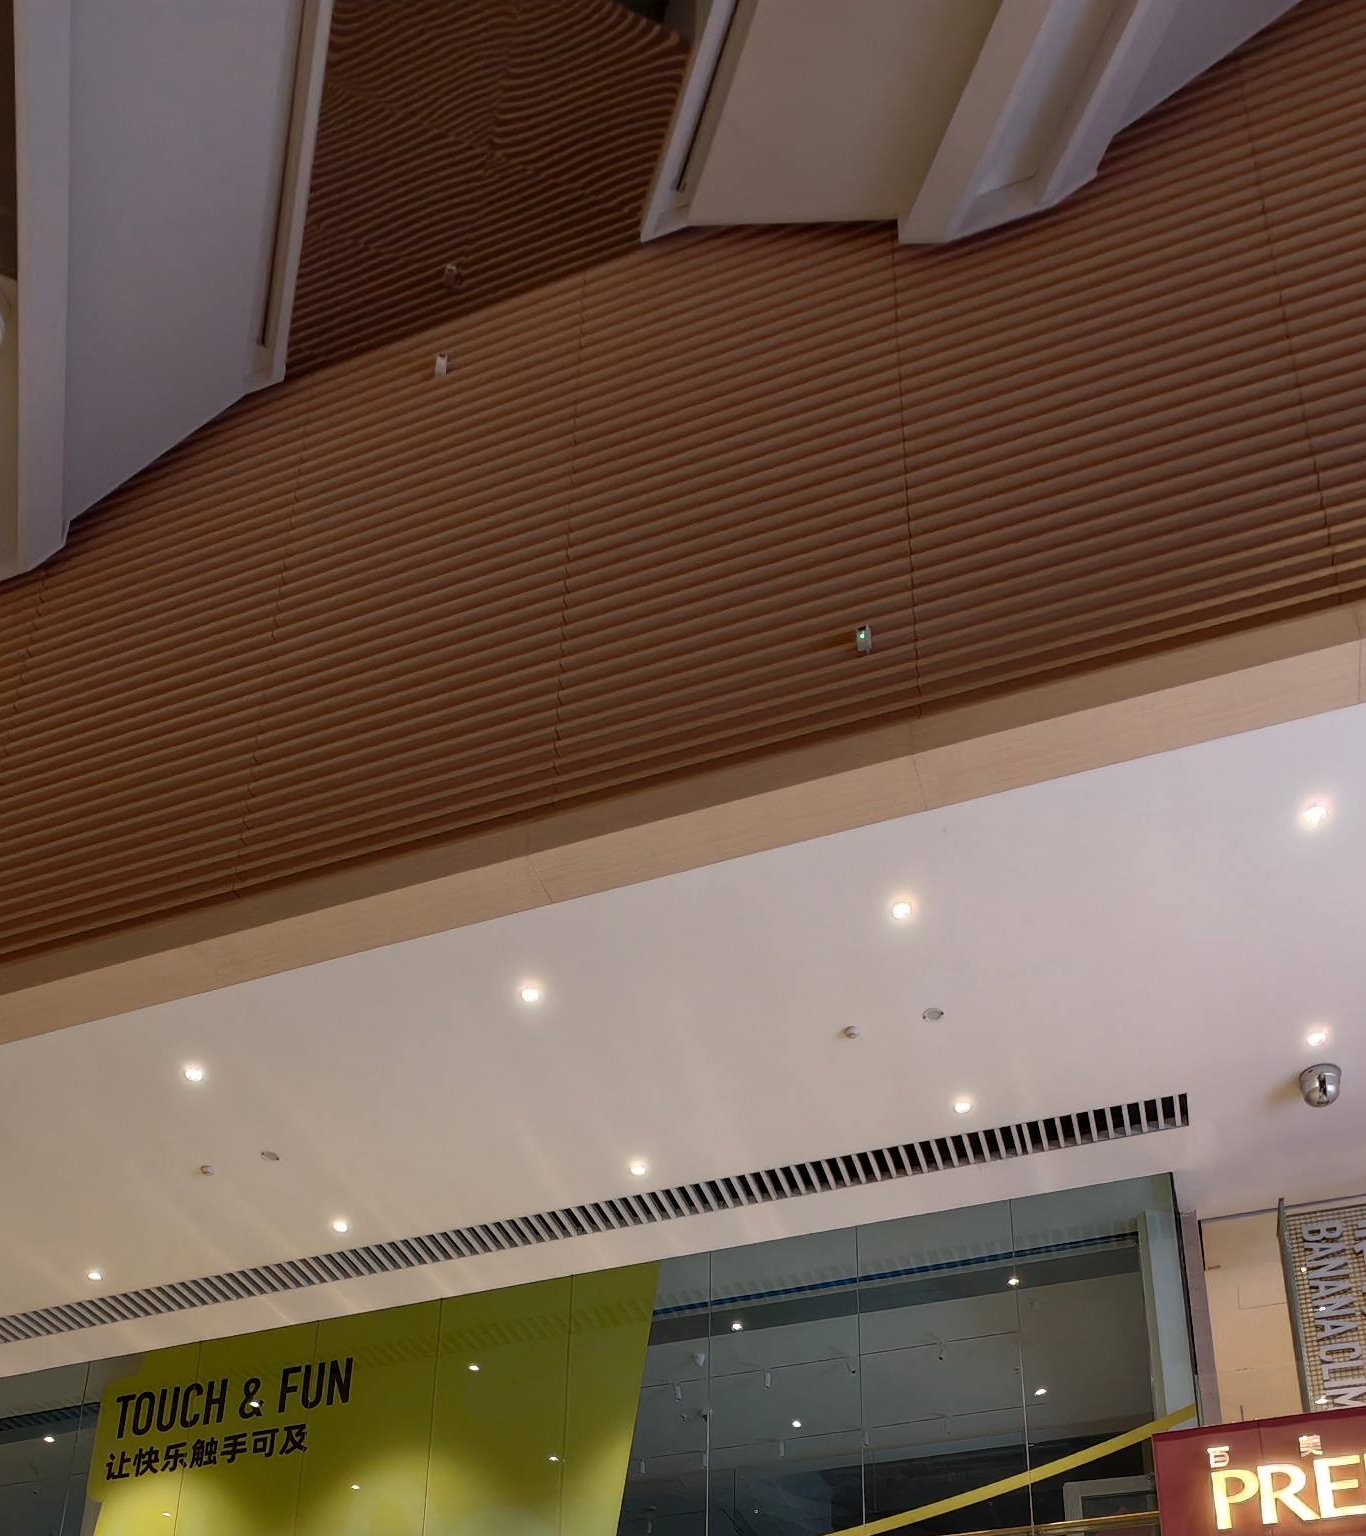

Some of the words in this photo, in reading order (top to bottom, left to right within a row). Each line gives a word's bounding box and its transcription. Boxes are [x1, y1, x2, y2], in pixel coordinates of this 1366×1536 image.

[1301, 1220, 1361, 1343] BANANA
[115, 1378, 230, 1439] TOUCH
[238, 1377, 265, 1420] &
[277, 1357, 354, 1414] FUN
[105, 1423, 308, 1482] 让快乐触手可及
